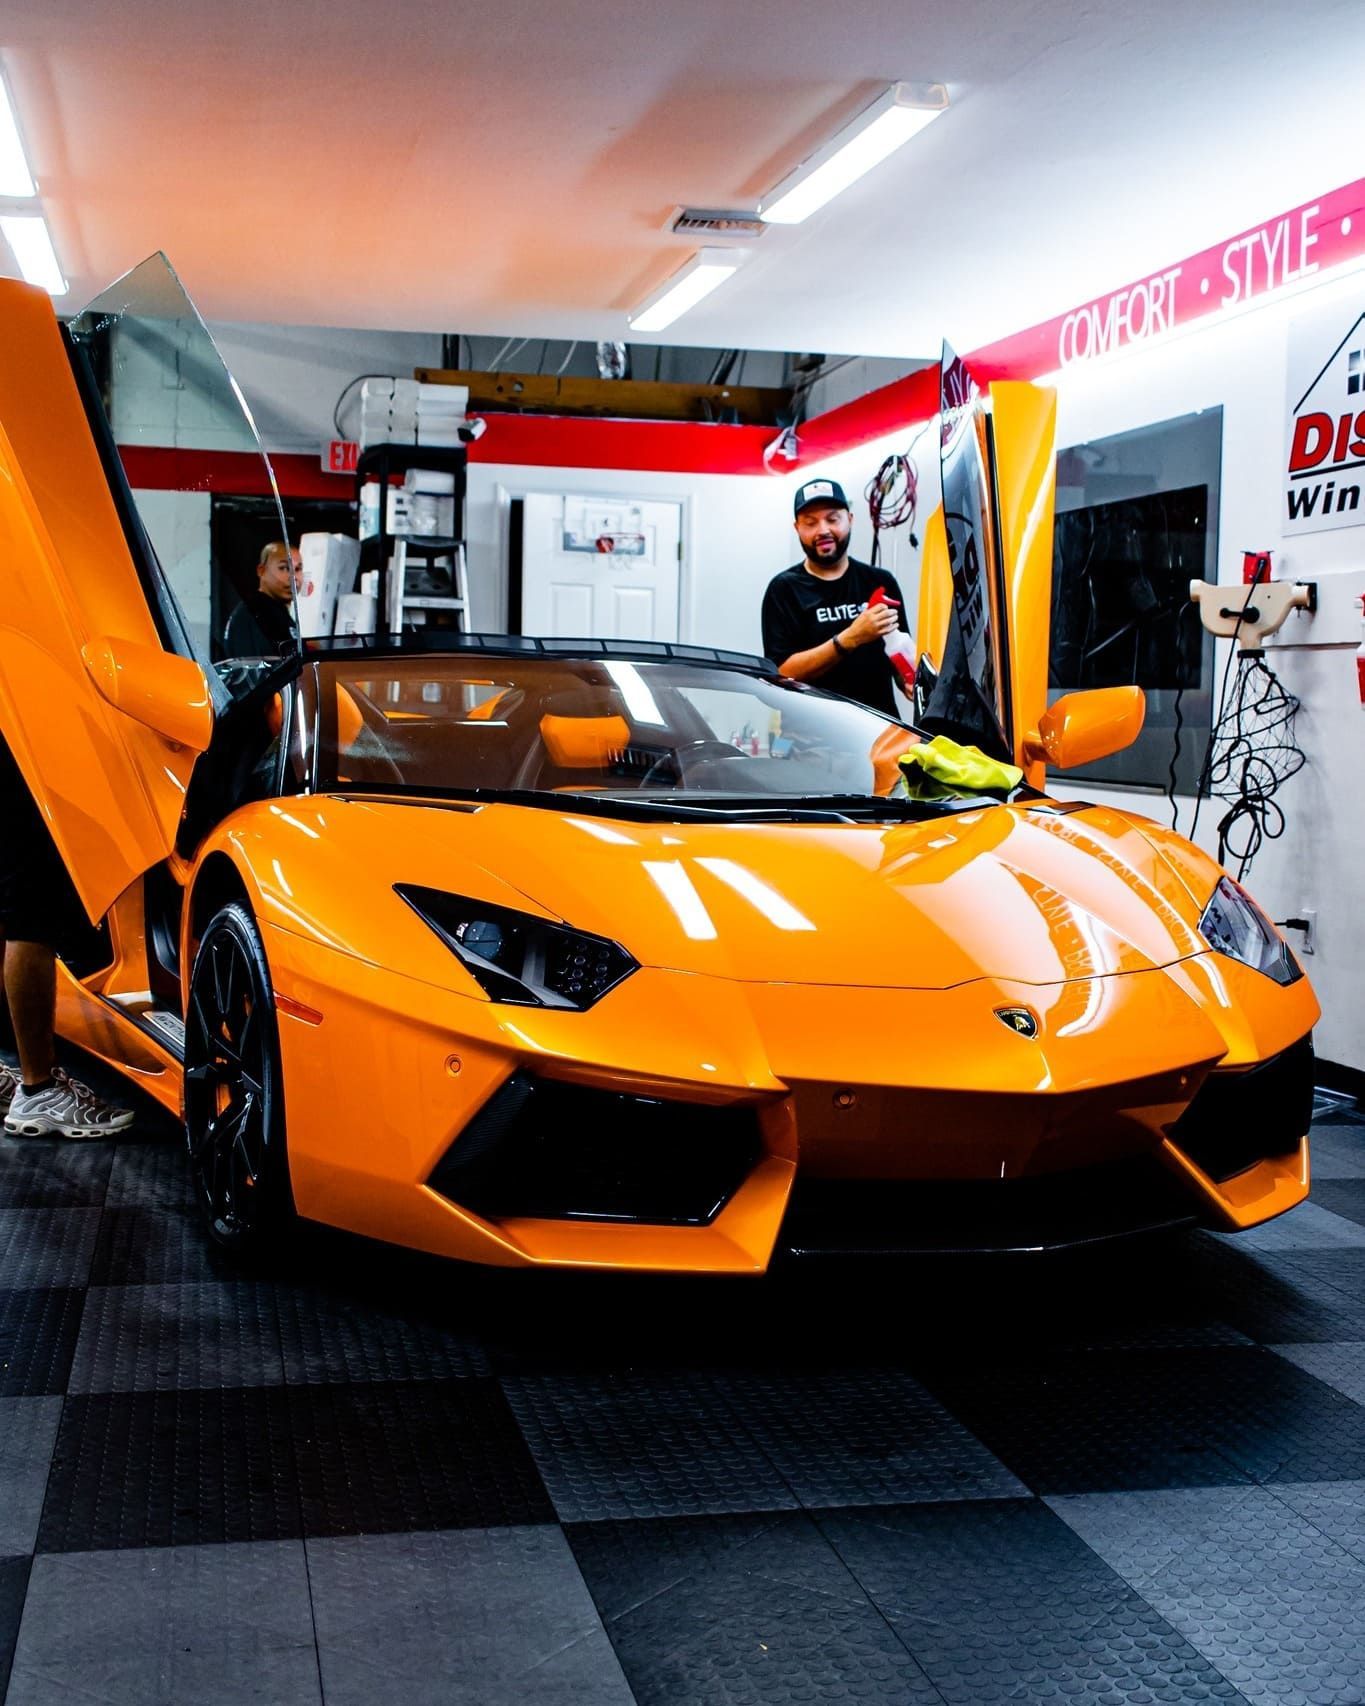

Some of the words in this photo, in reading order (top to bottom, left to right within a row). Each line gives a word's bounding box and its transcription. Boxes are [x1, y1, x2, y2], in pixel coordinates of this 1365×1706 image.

[1059, 268, 1182, 368] COMFORT
[1221, 204, 1320, 309] STYLE
[815, 603, 859, 623] ELITE
